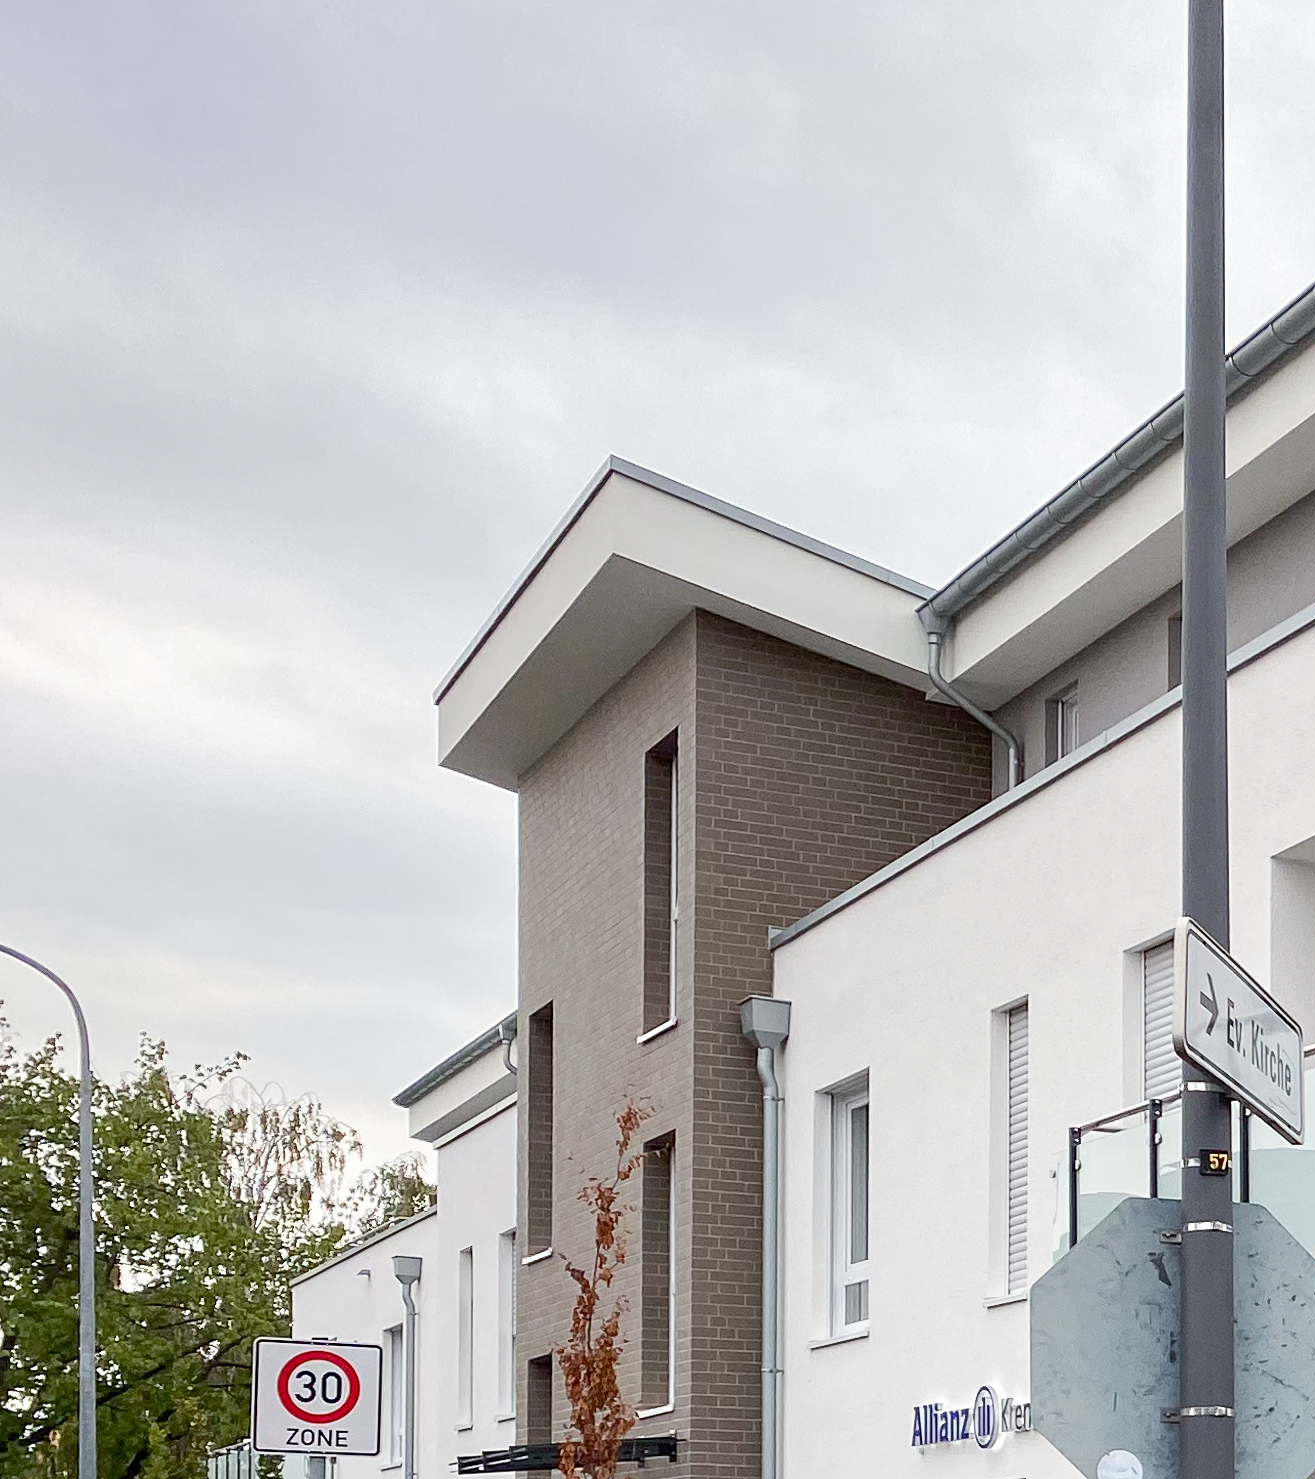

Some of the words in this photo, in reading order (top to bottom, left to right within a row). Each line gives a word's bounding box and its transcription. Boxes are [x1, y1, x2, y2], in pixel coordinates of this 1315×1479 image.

[1226, 997, 1246, 1058] Ev.
[1250, 1019, 1292, 1097] Kirche
[1208, 1152, 1229, 1171] 57
[294, 1370, 343, 1404] 30
[285, 1427, 349, 1448] ZONE
[911, 1402, 970, 1447] Allianz
